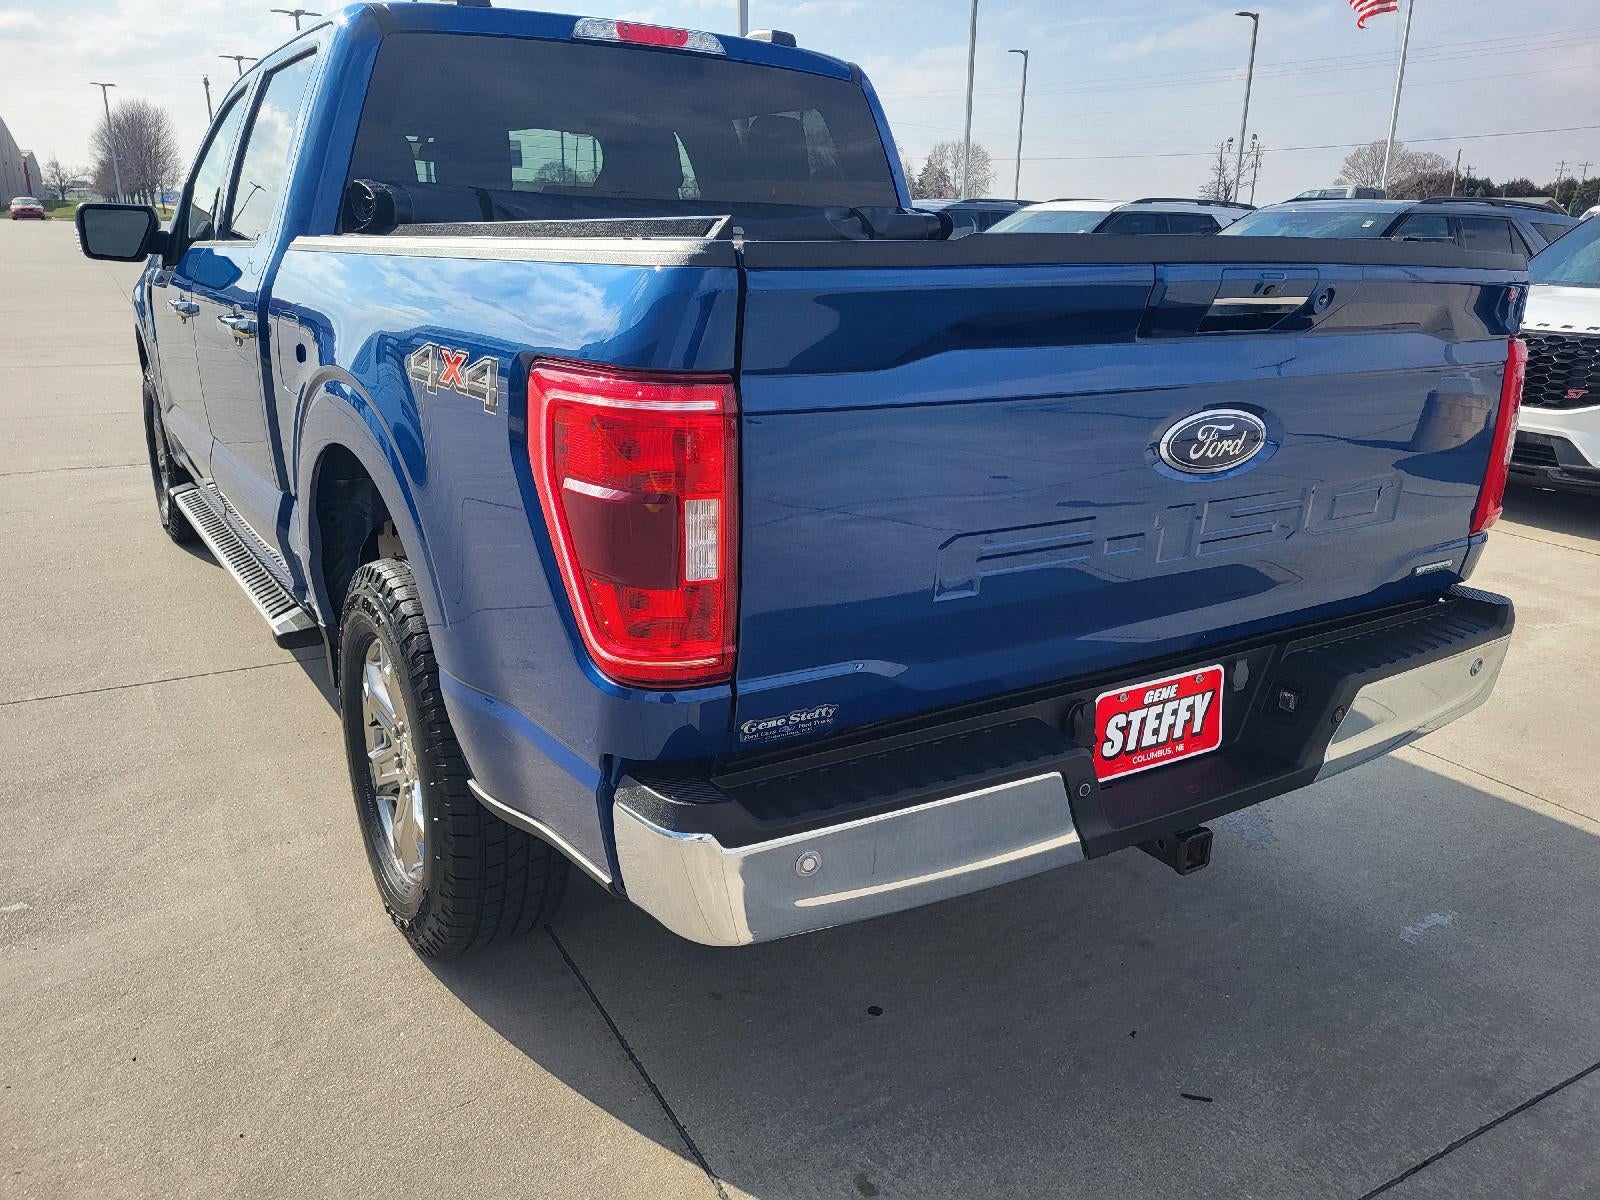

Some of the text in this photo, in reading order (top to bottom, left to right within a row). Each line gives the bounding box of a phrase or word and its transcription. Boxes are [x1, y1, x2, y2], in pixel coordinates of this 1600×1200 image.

[1189, 423, 1247, 460] Ford
[934, 480, 1401, 601] F-150
[1144, 683, 1179, 705] GENE
[743, 706, 837, 734] Gene Steffy
[1102, 690, 1214, 758] STEFFY
[1132, 743, 1185, 764] COLUMBUS, NE
